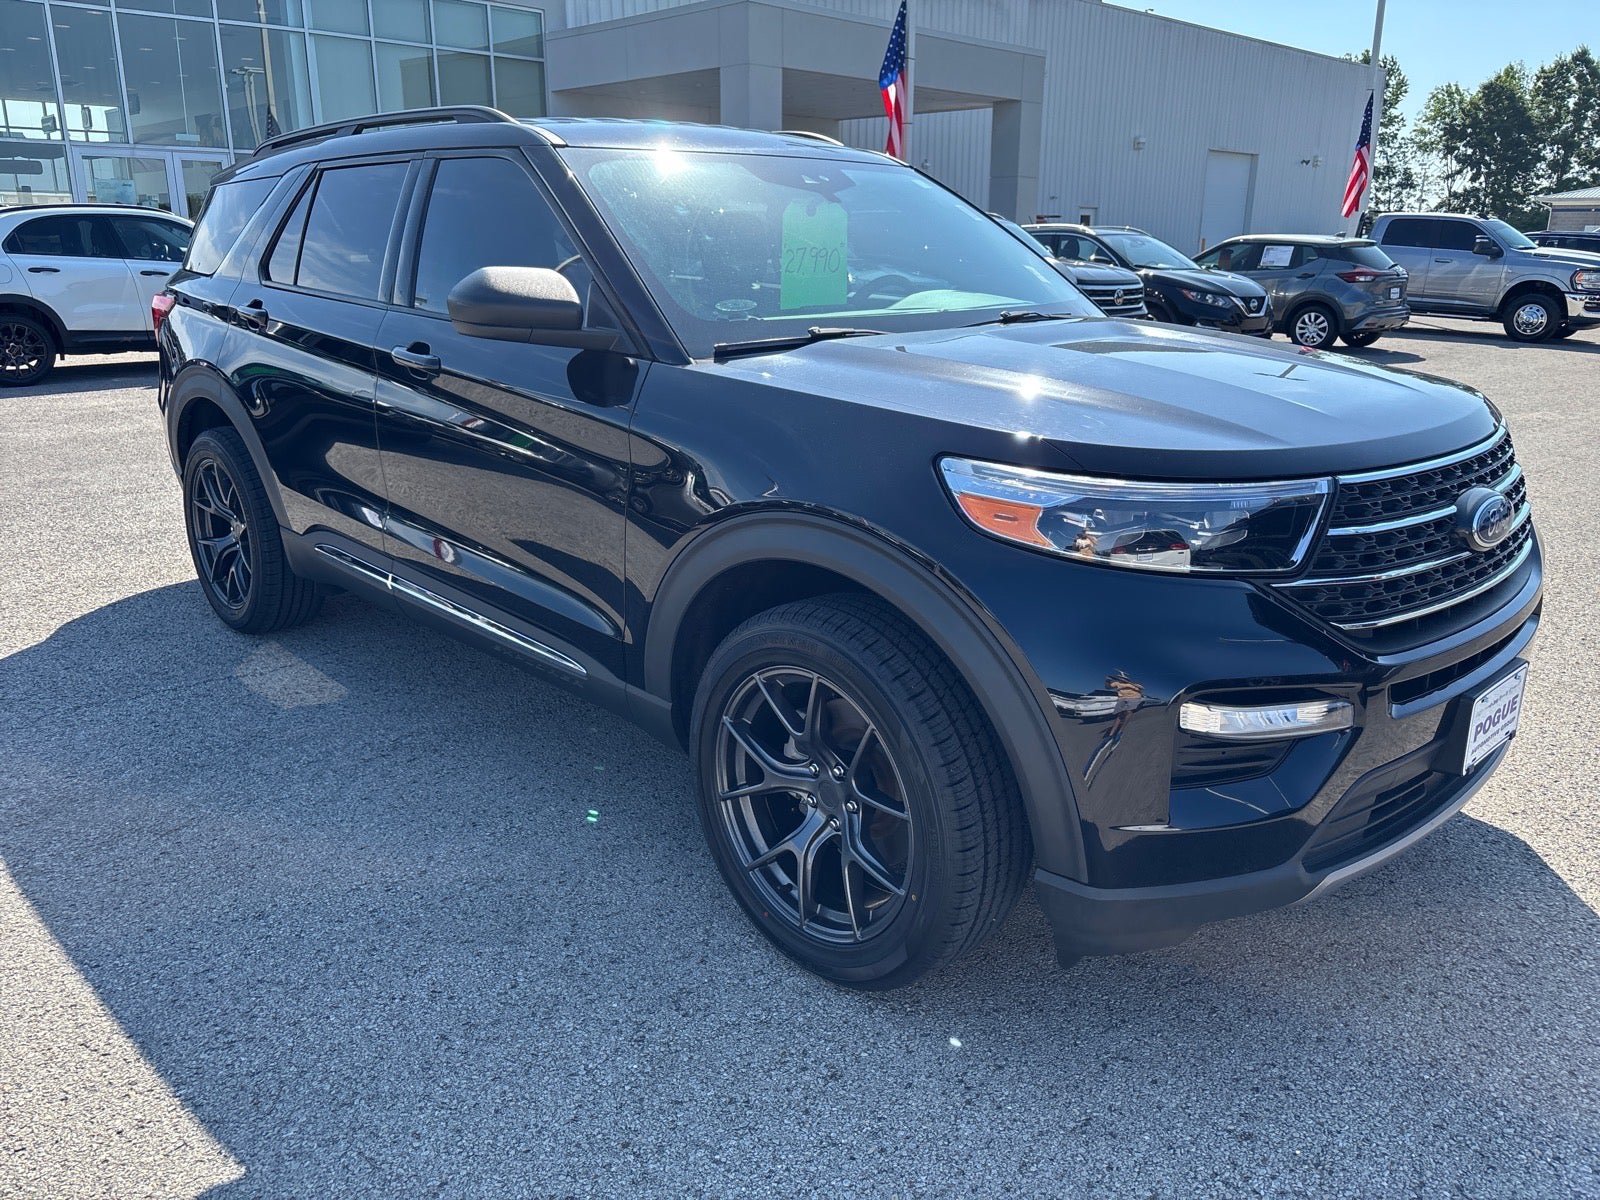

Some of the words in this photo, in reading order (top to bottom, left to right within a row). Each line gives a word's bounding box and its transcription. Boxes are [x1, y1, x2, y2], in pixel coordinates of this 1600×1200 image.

[1471, 727, 1500, 755] AUTOMOTIVE
[1497, 715, 1516, 731] GROUP
[1473, 693, 1519, 743] POGUE
